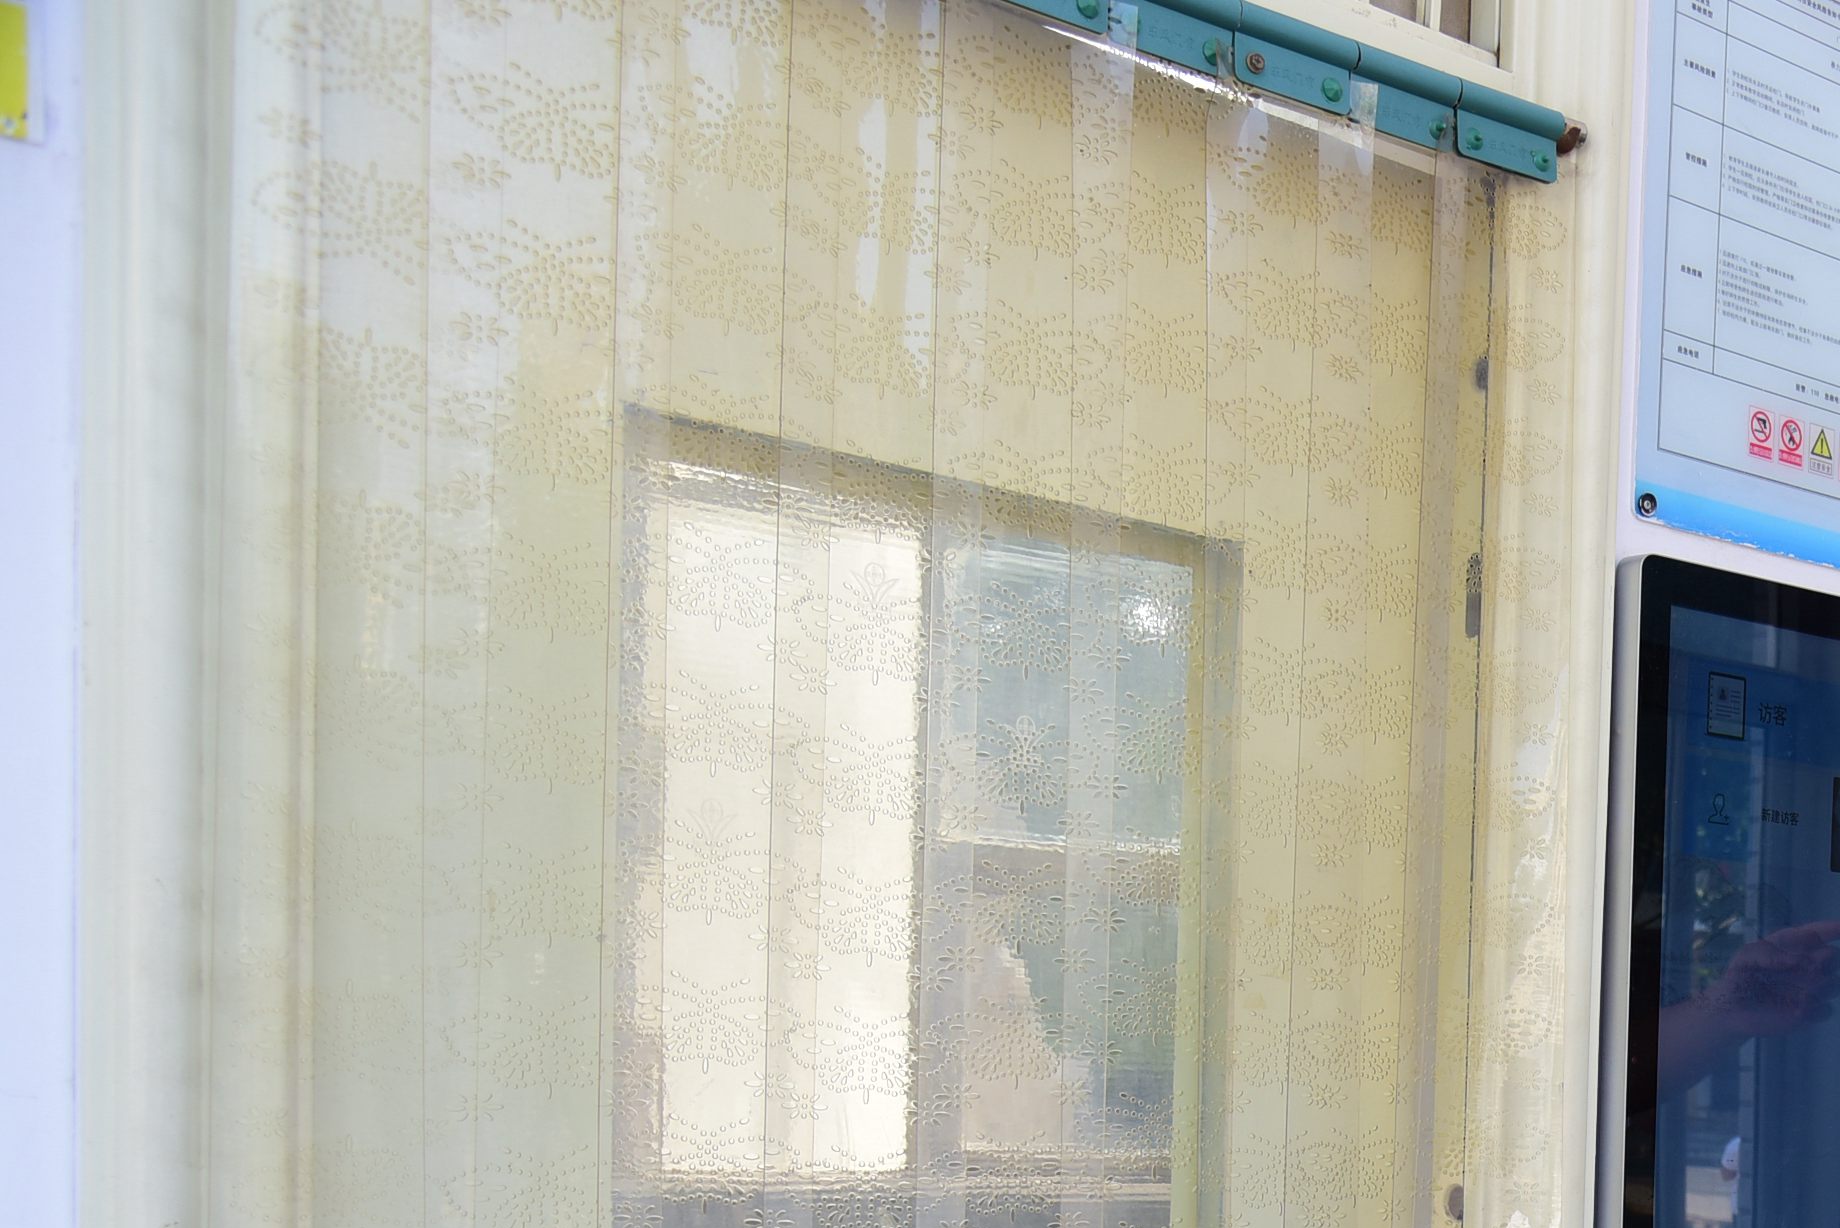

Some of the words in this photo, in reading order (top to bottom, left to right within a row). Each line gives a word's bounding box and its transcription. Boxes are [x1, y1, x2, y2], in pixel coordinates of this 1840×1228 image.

[1758, 703, 1788, 727] 访客
[1761, 808, 1800, 827] 新建访客
